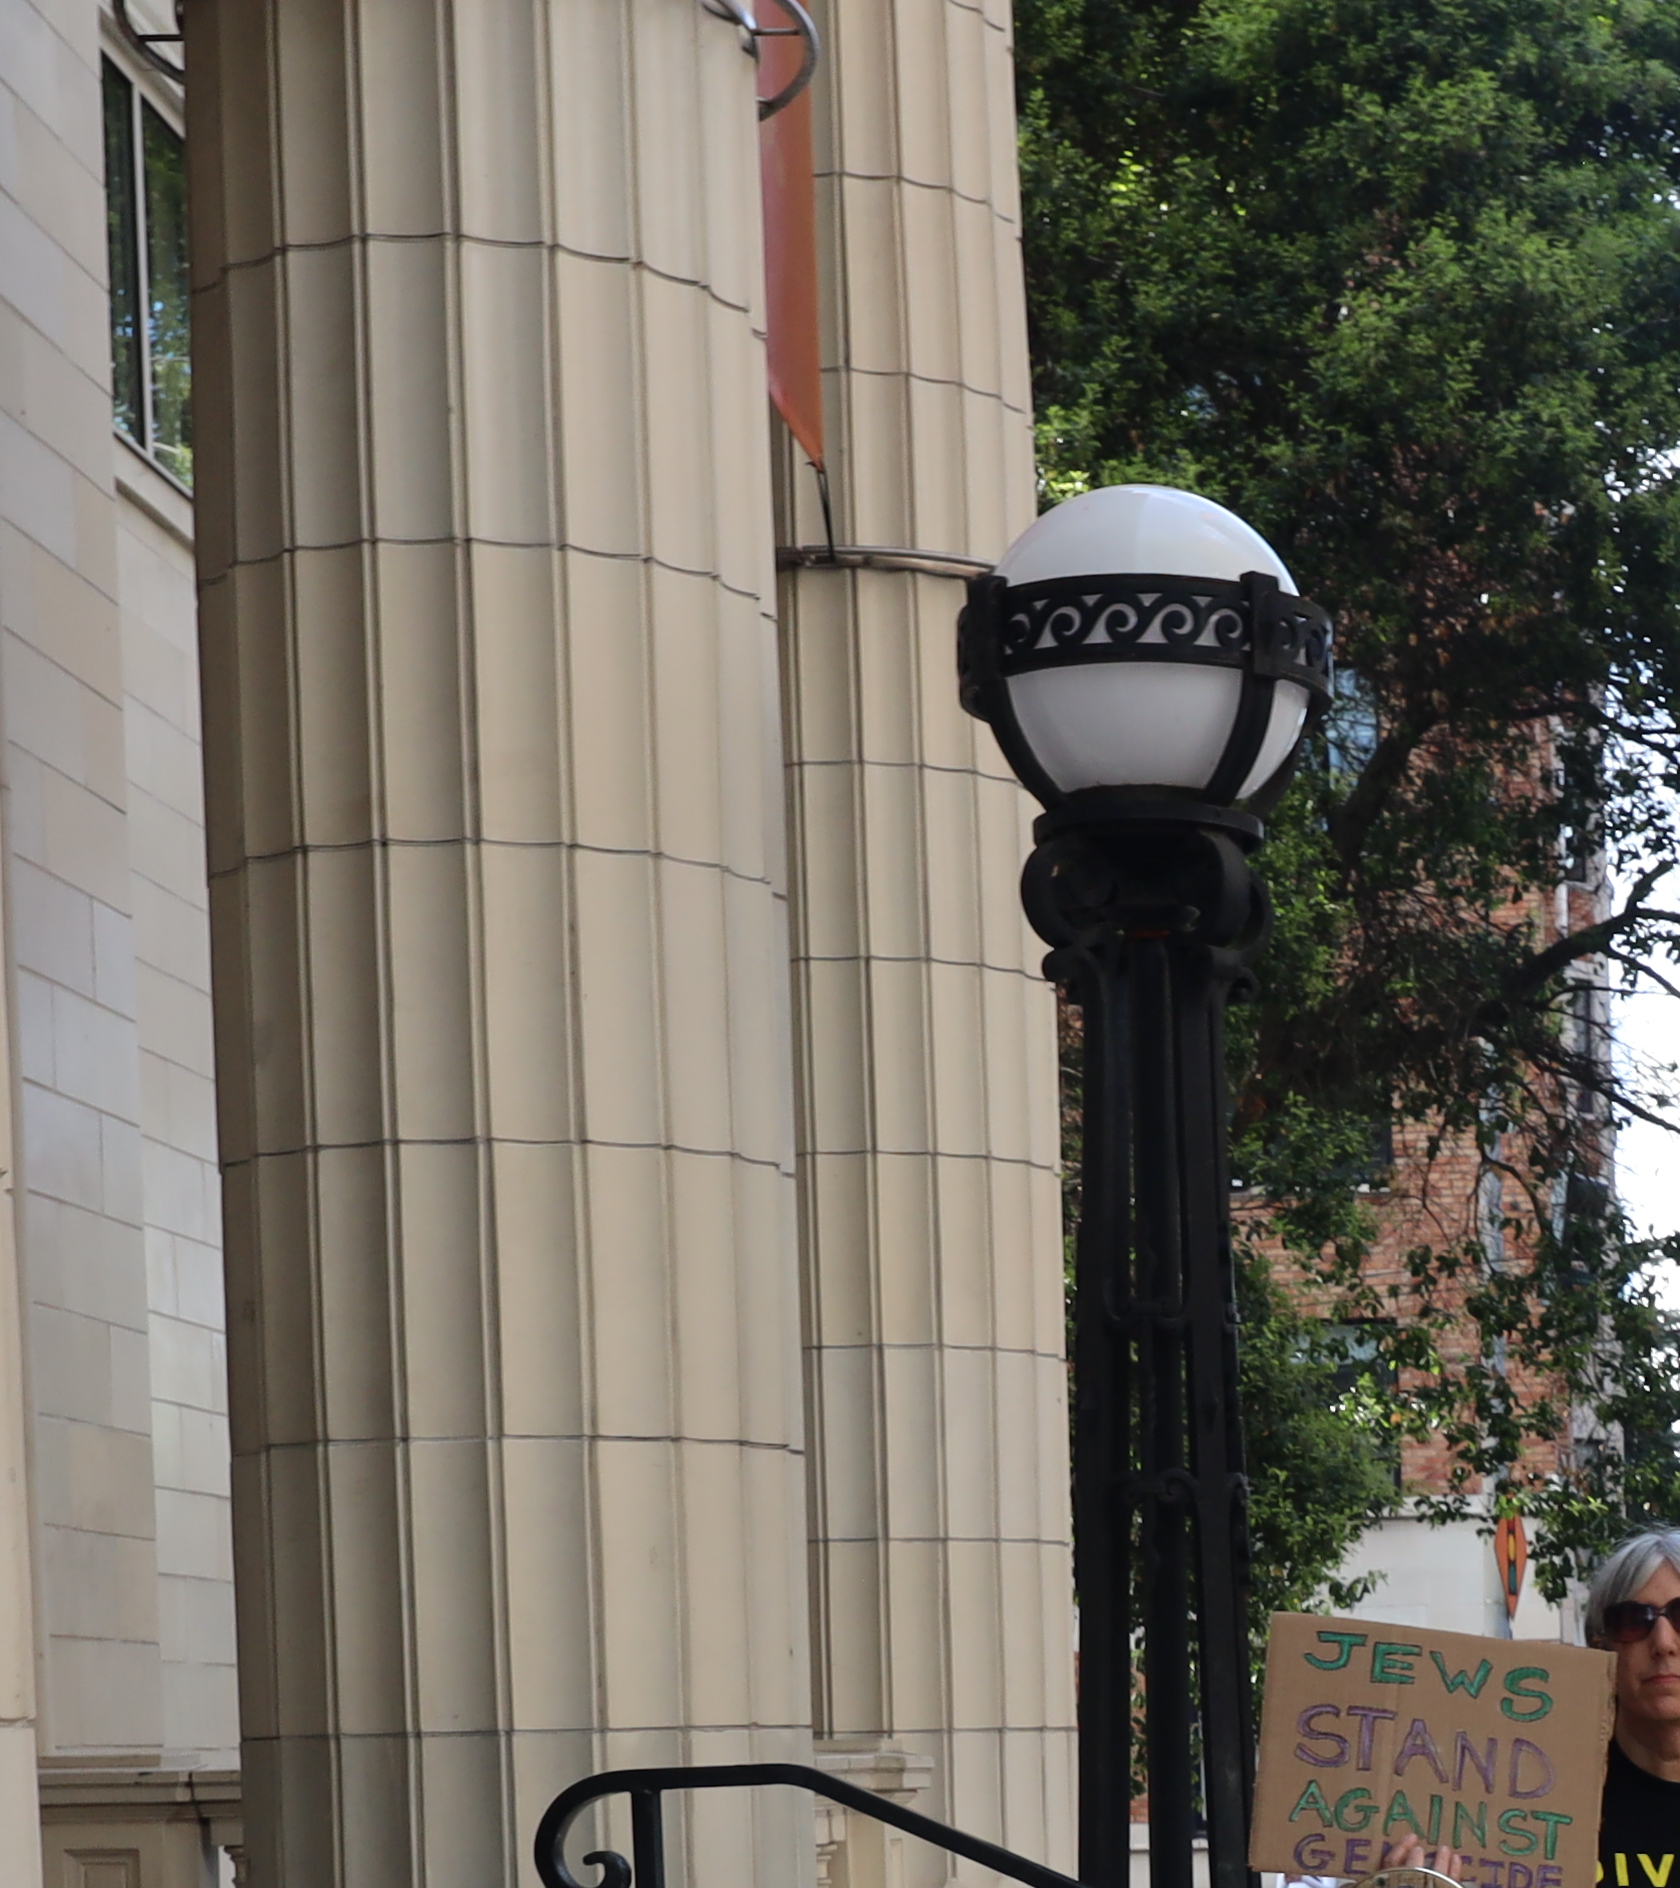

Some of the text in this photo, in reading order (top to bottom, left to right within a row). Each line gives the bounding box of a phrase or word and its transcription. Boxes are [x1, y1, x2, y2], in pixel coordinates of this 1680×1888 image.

[1303, 1631, 1554, 1722] JEWS
[1294, 1704, 1556, 1799] STAND
[1288, 1779, 1573, 1860] AGAINST
